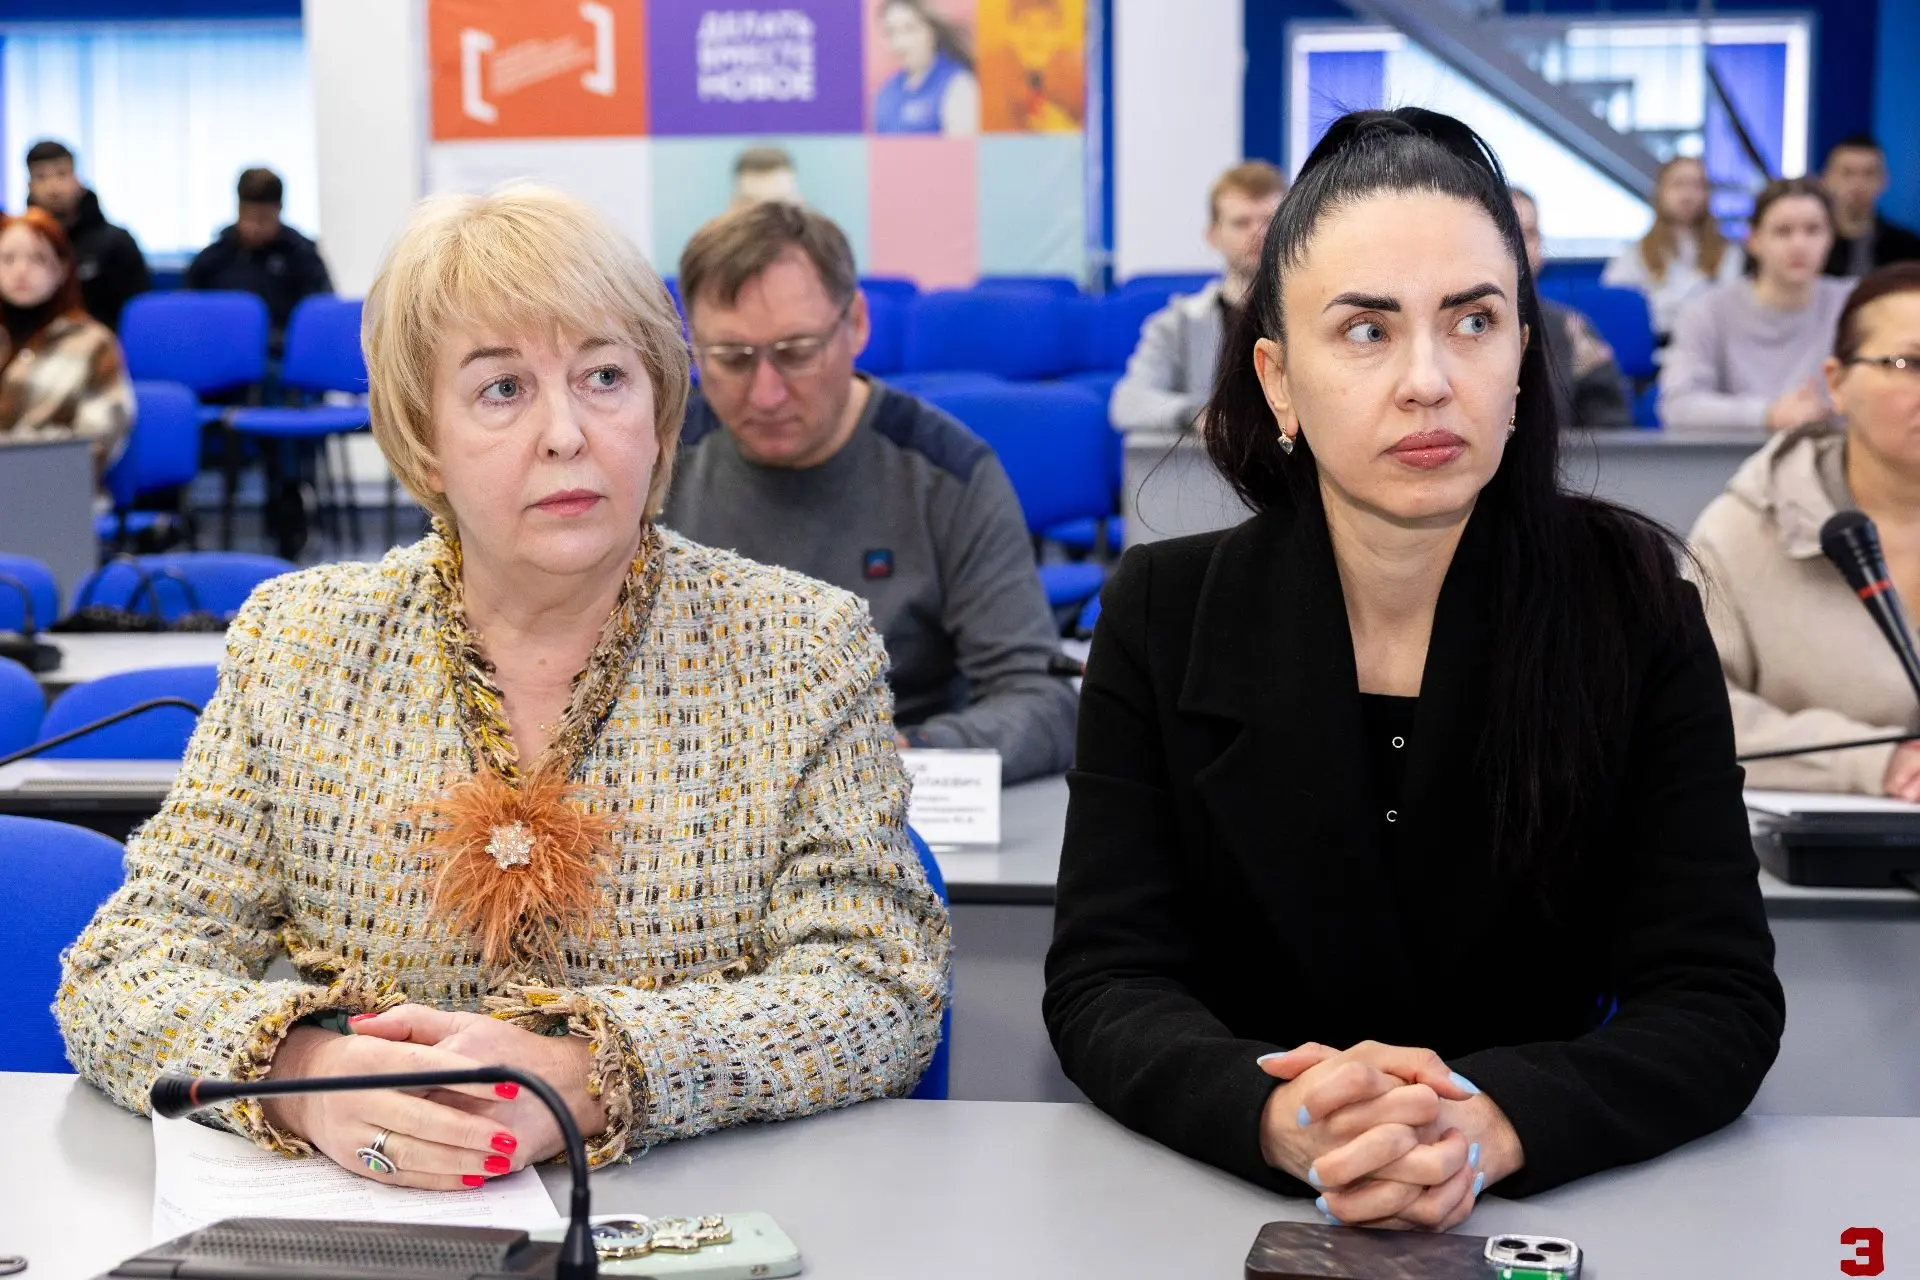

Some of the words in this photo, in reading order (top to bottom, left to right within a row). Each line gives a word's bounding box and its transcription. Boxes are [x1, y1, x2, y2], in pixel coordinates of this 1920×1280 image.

[697, 9, 815, 41] ДЕЛАТЬ
[697, 42, 815, 71] ВМЕСТЕ
[697, 73, 816, 102] НОВОЕ
